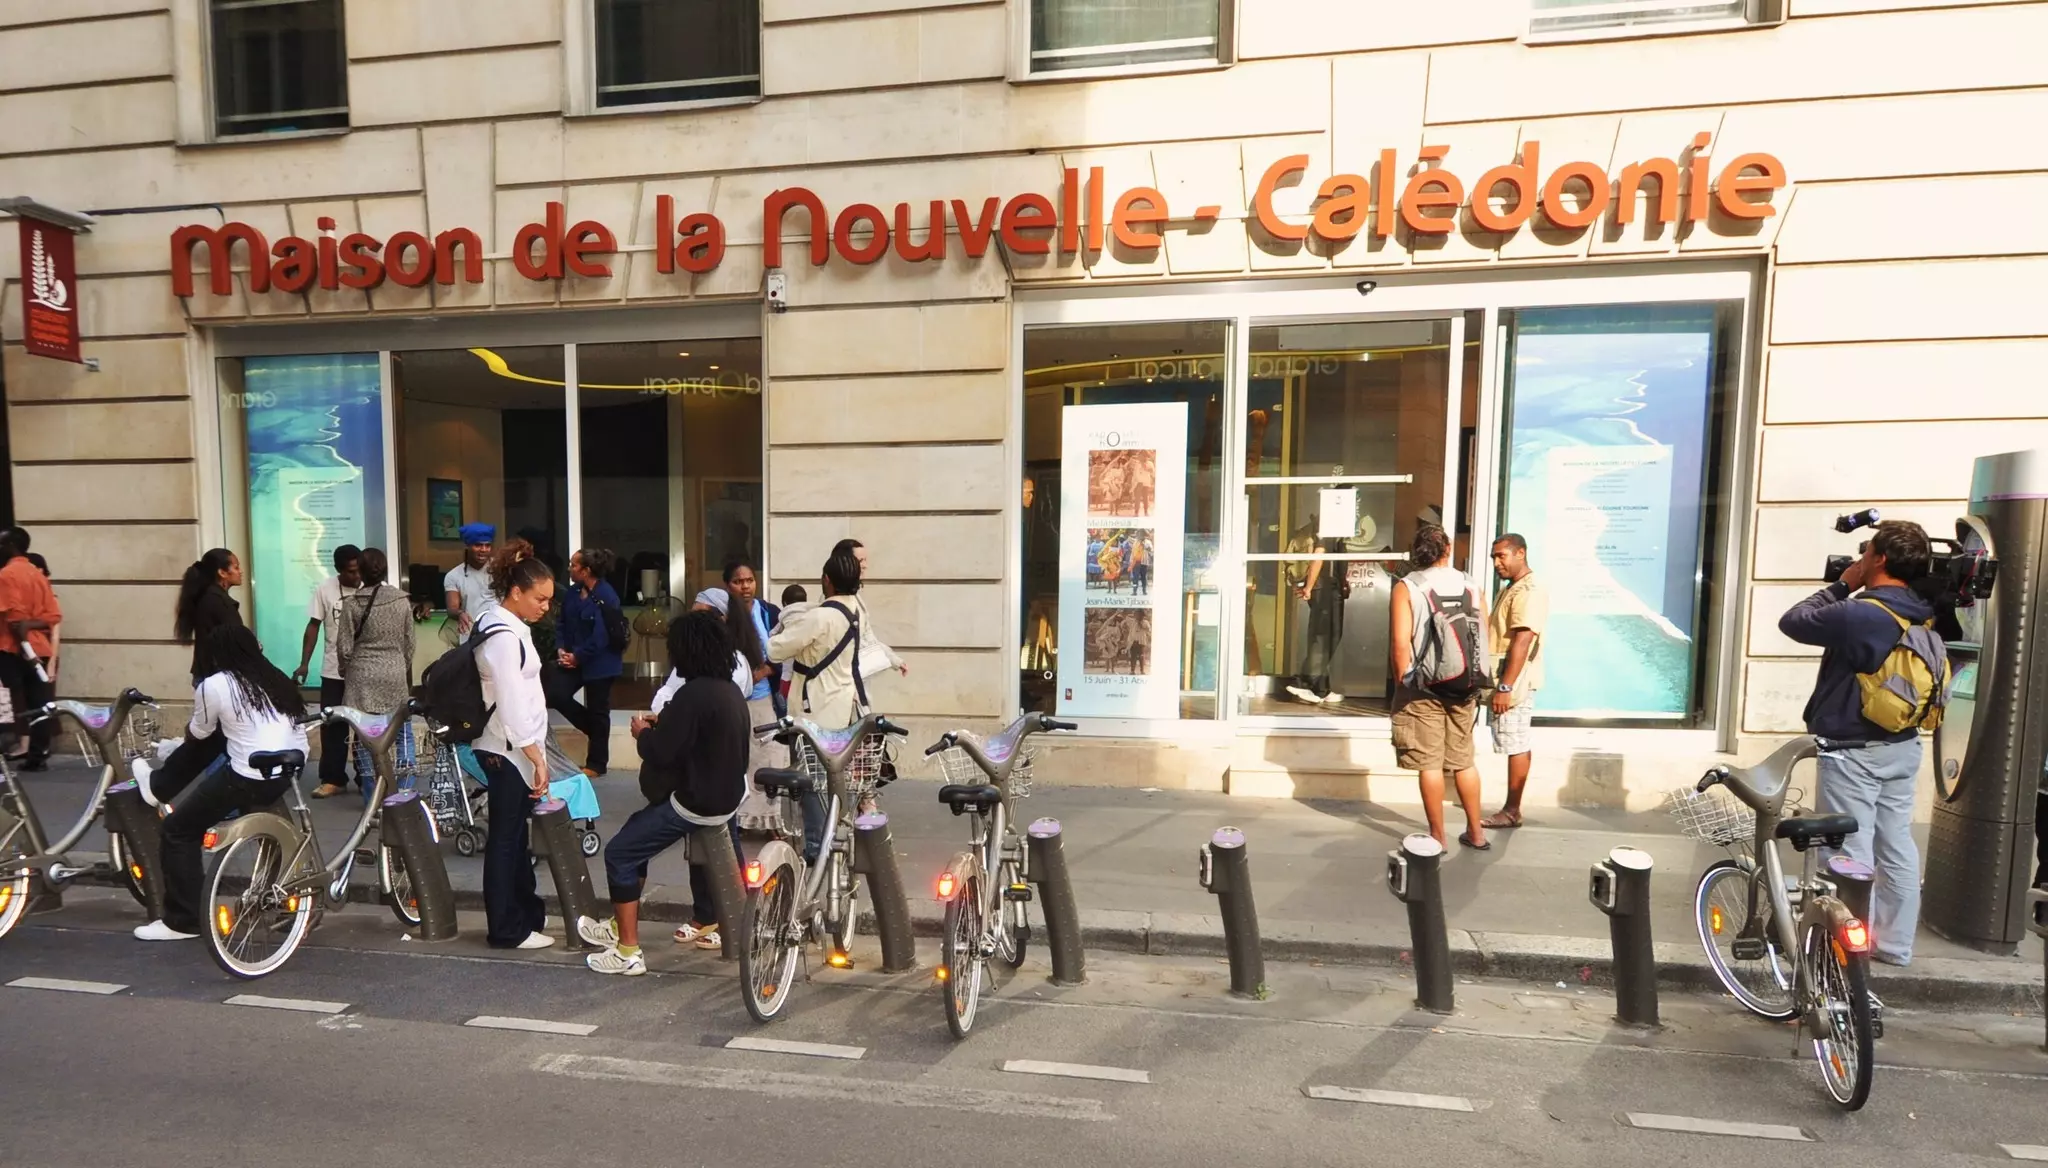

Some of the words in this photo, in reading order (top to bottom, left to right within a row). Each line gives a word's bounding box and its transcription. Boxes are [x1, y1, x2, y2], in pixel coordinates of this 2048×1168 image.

[512, 200, 618, 281] de
[655, 194, 726, 274] la
[1254, 130, 1788, 243] Calédonie
[1085, 597, 1126, 606] Jean-Marie
[1084, 676, 1093, 684] 15
[1119, 676, 1129, 684] 31
